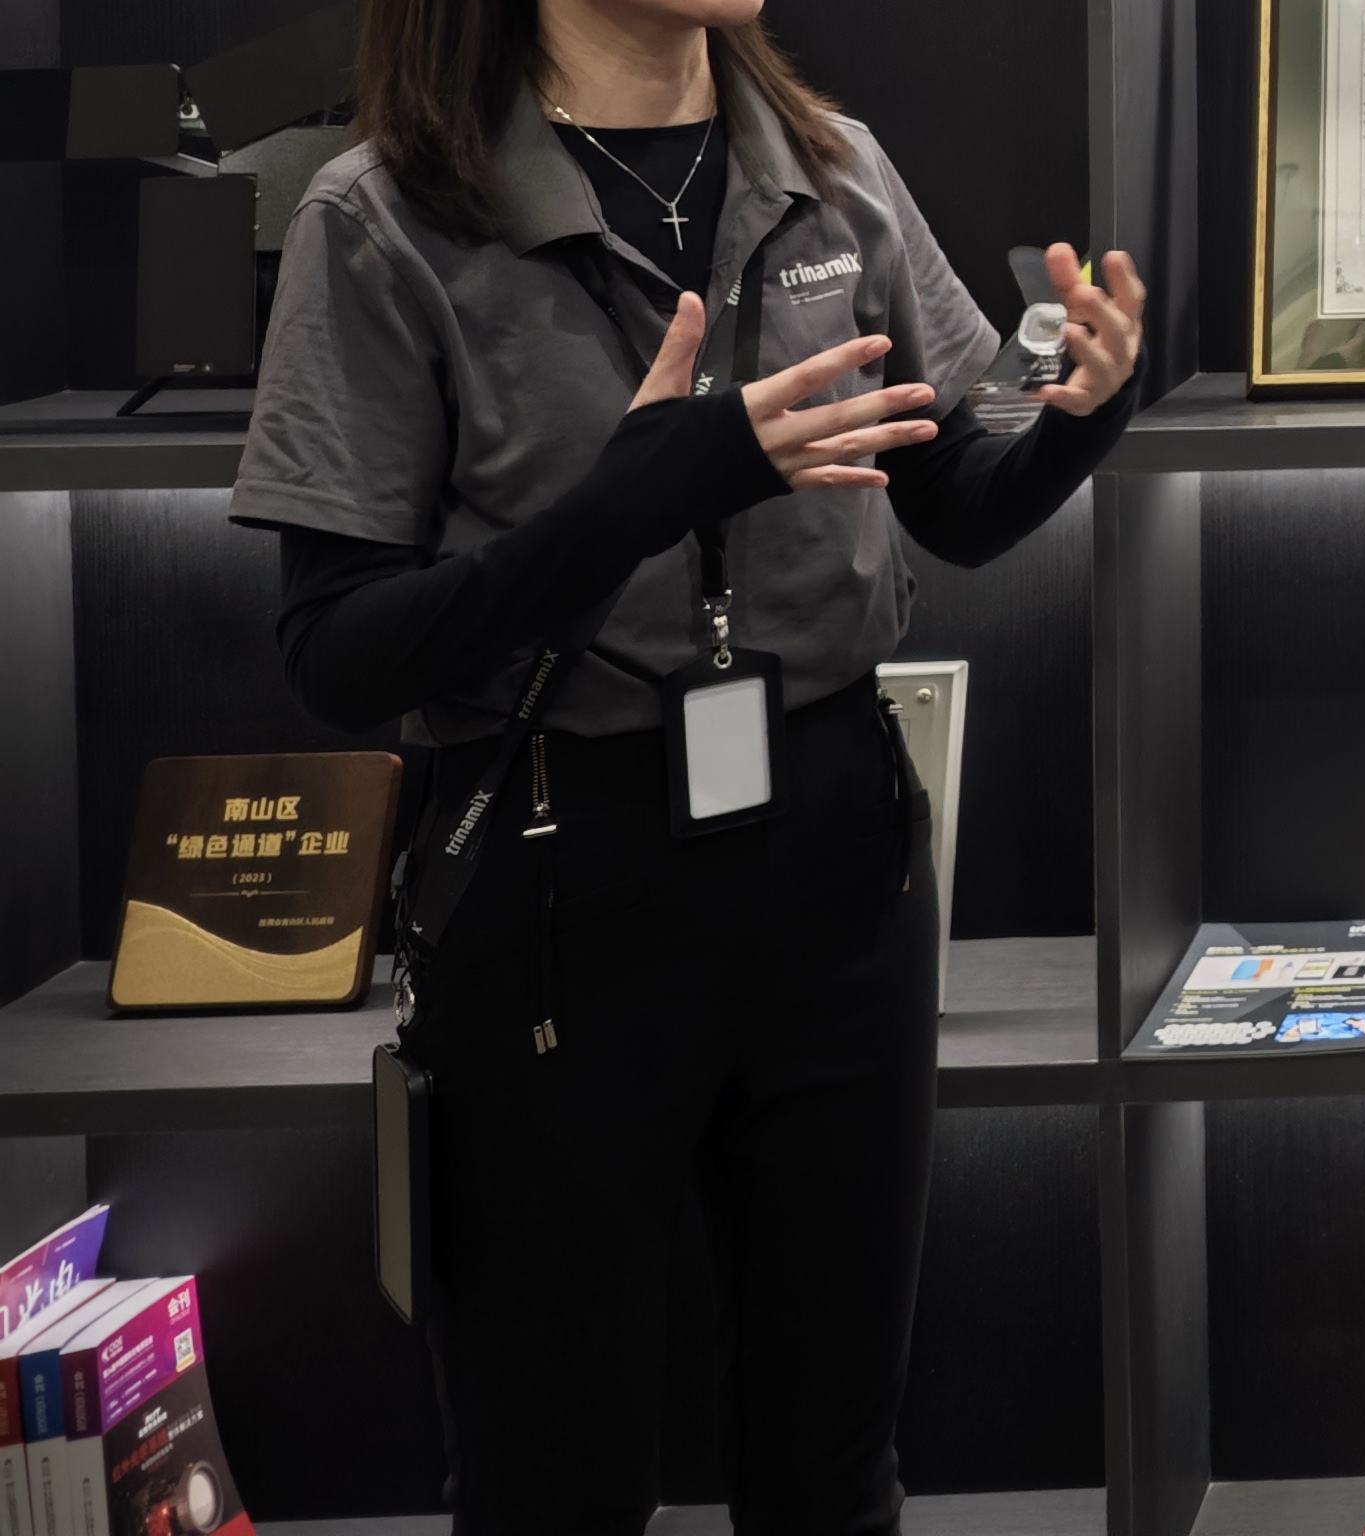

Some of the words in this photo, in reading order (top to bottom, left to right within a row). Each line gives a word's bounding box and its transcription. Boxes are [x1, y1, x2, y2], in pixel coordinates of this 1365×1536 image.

[779, 252, 863, 289] trinamiX
[518, 648, 560, 720] trinamiX
[223, 795, 301, 821] 南山区
[445, 789, 494, 856] trinamiX
[166, 830, 350, 860] “绿色通道”企业
